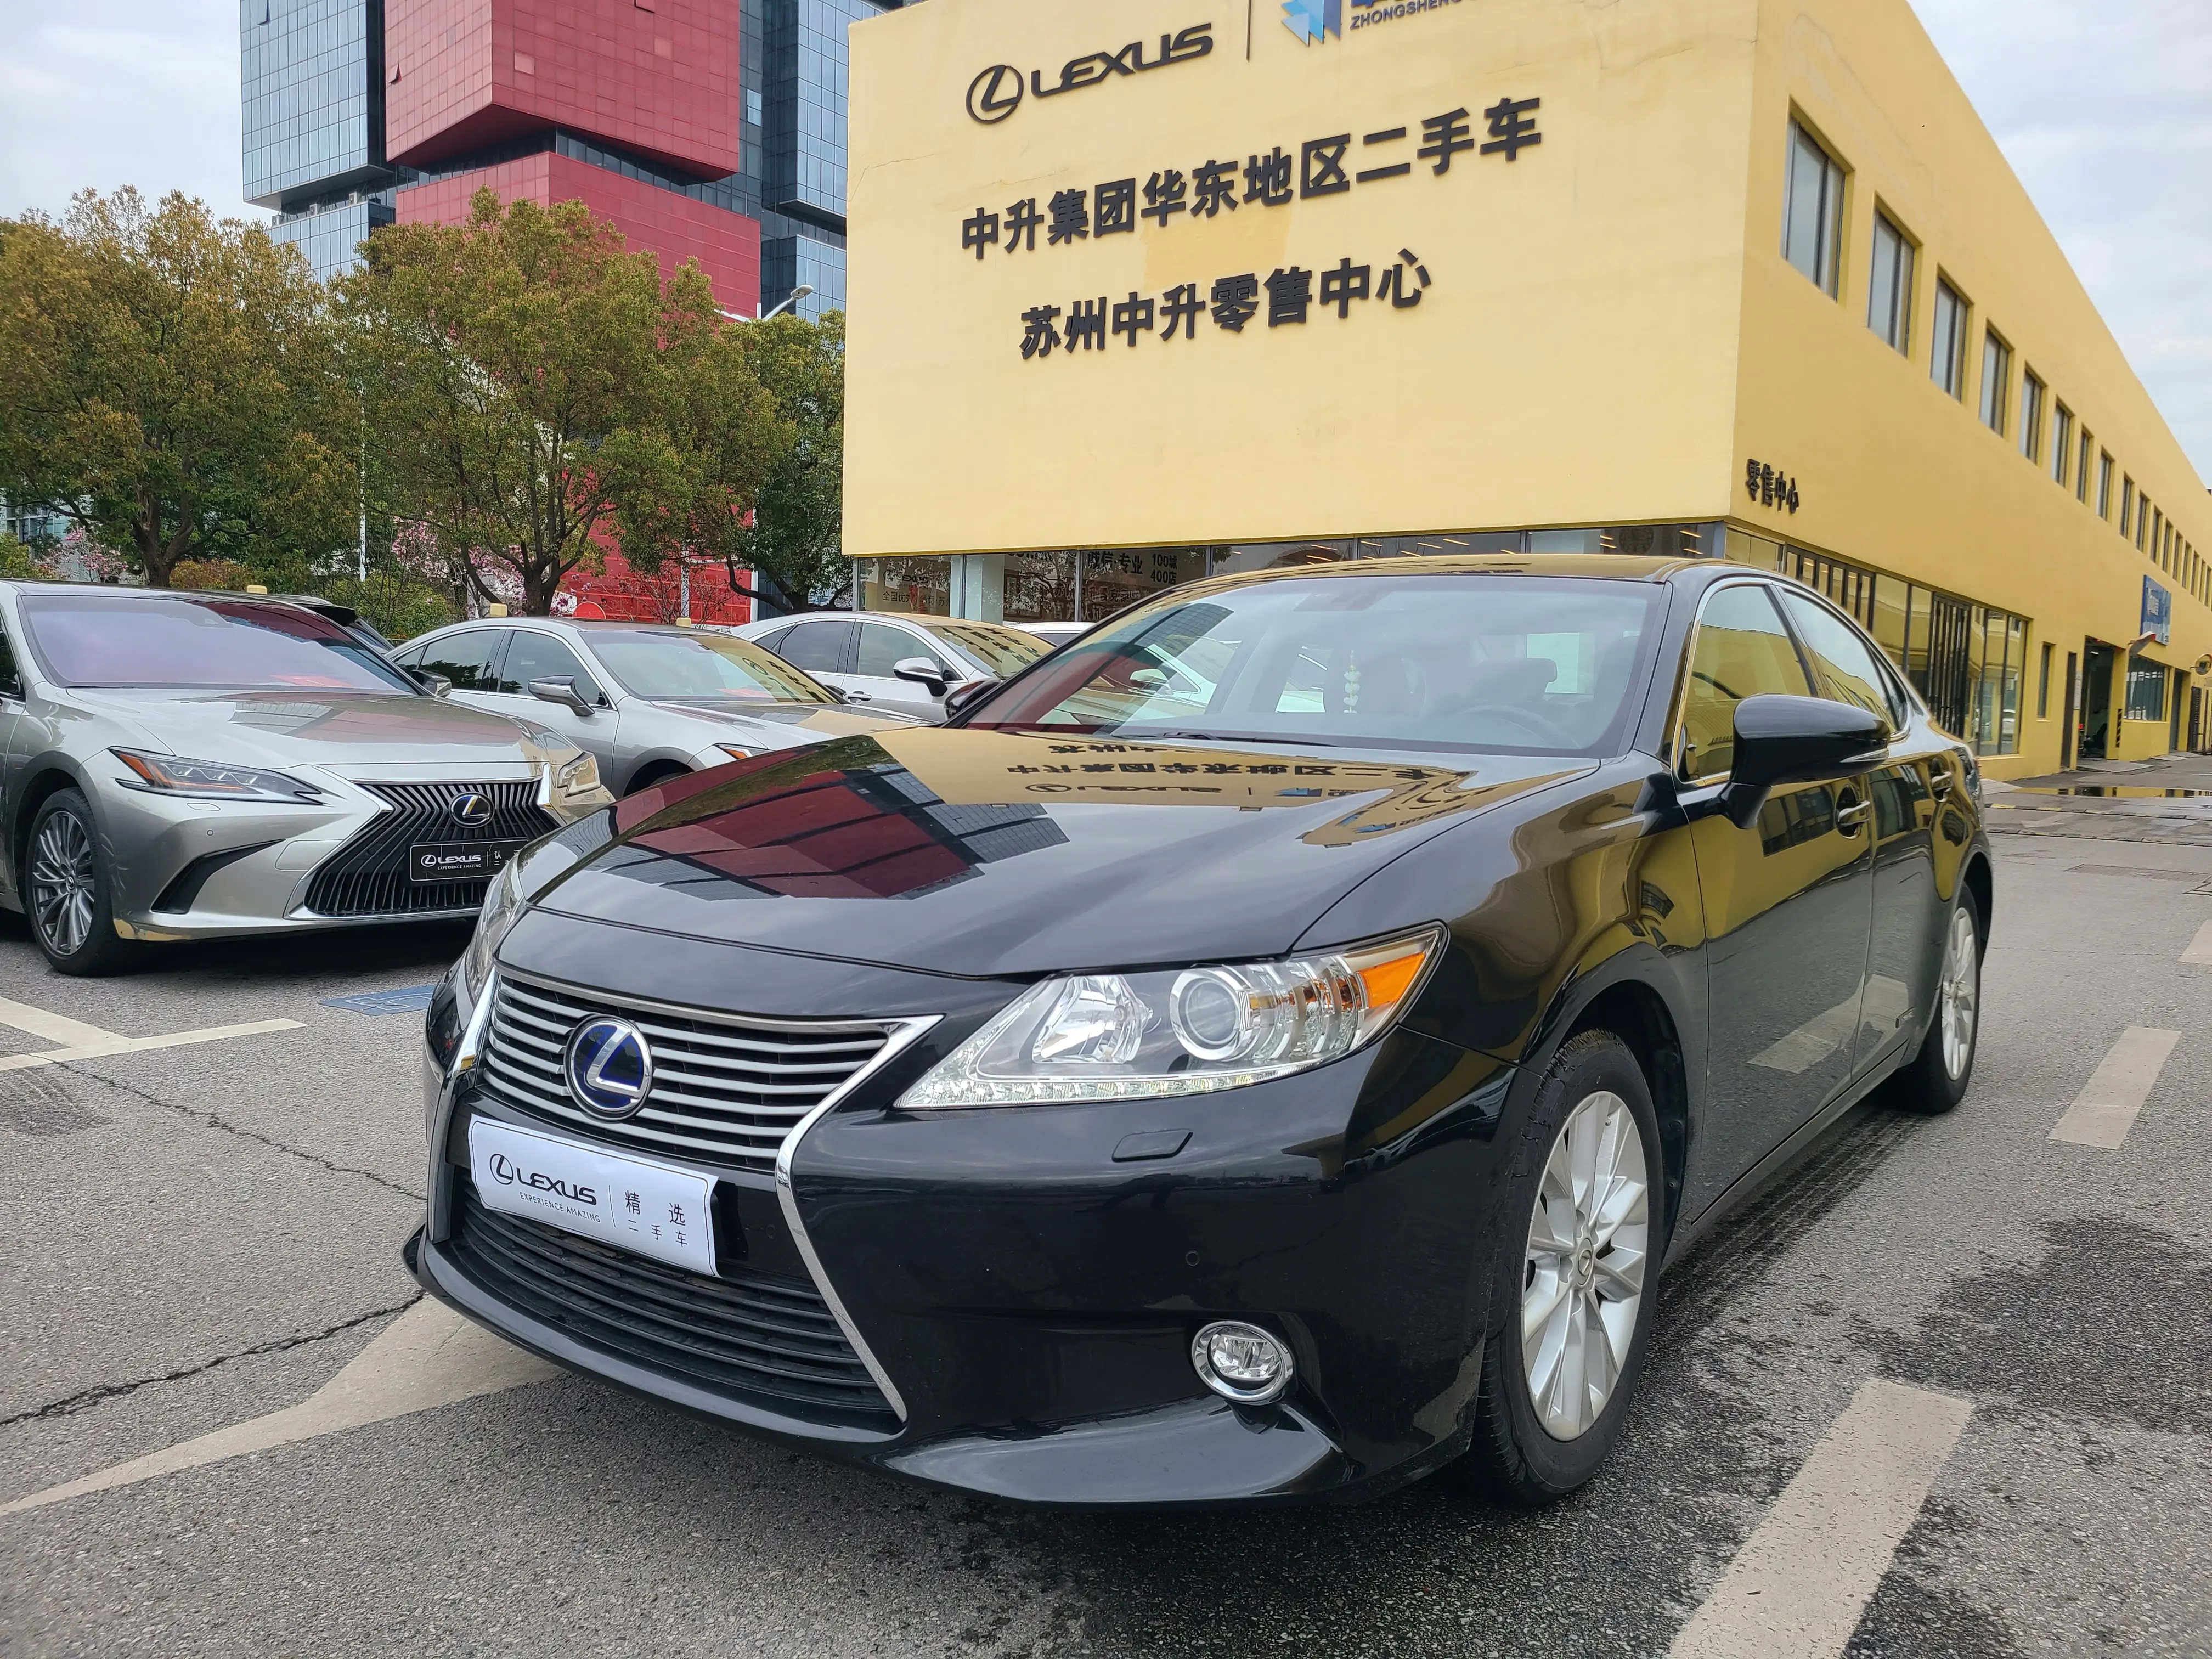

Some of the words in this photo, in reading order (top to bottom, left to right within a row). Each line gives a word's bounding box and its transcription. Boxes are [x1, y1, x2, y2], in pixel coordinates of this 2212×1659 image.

[1031, 23, 1214, 98] LEXUS
[962, 98, 1542, 259] 中升集团华东地区二手车
[1019, 249, 1431, 359] 苏州中升零售中心
[1746, 459, 1799, 514] 零售中心
[1150, 569, 1177, 585] 400店
[438, 855, 481, 864] LEXUS
[516, 1167, 597, 1205] LEXUS
[520, 1192, 564, 1212] EXPERIENCE
[566, 1206, 601, 1223] AMAZING
[628, 1220, 688, 1248] 二手车
